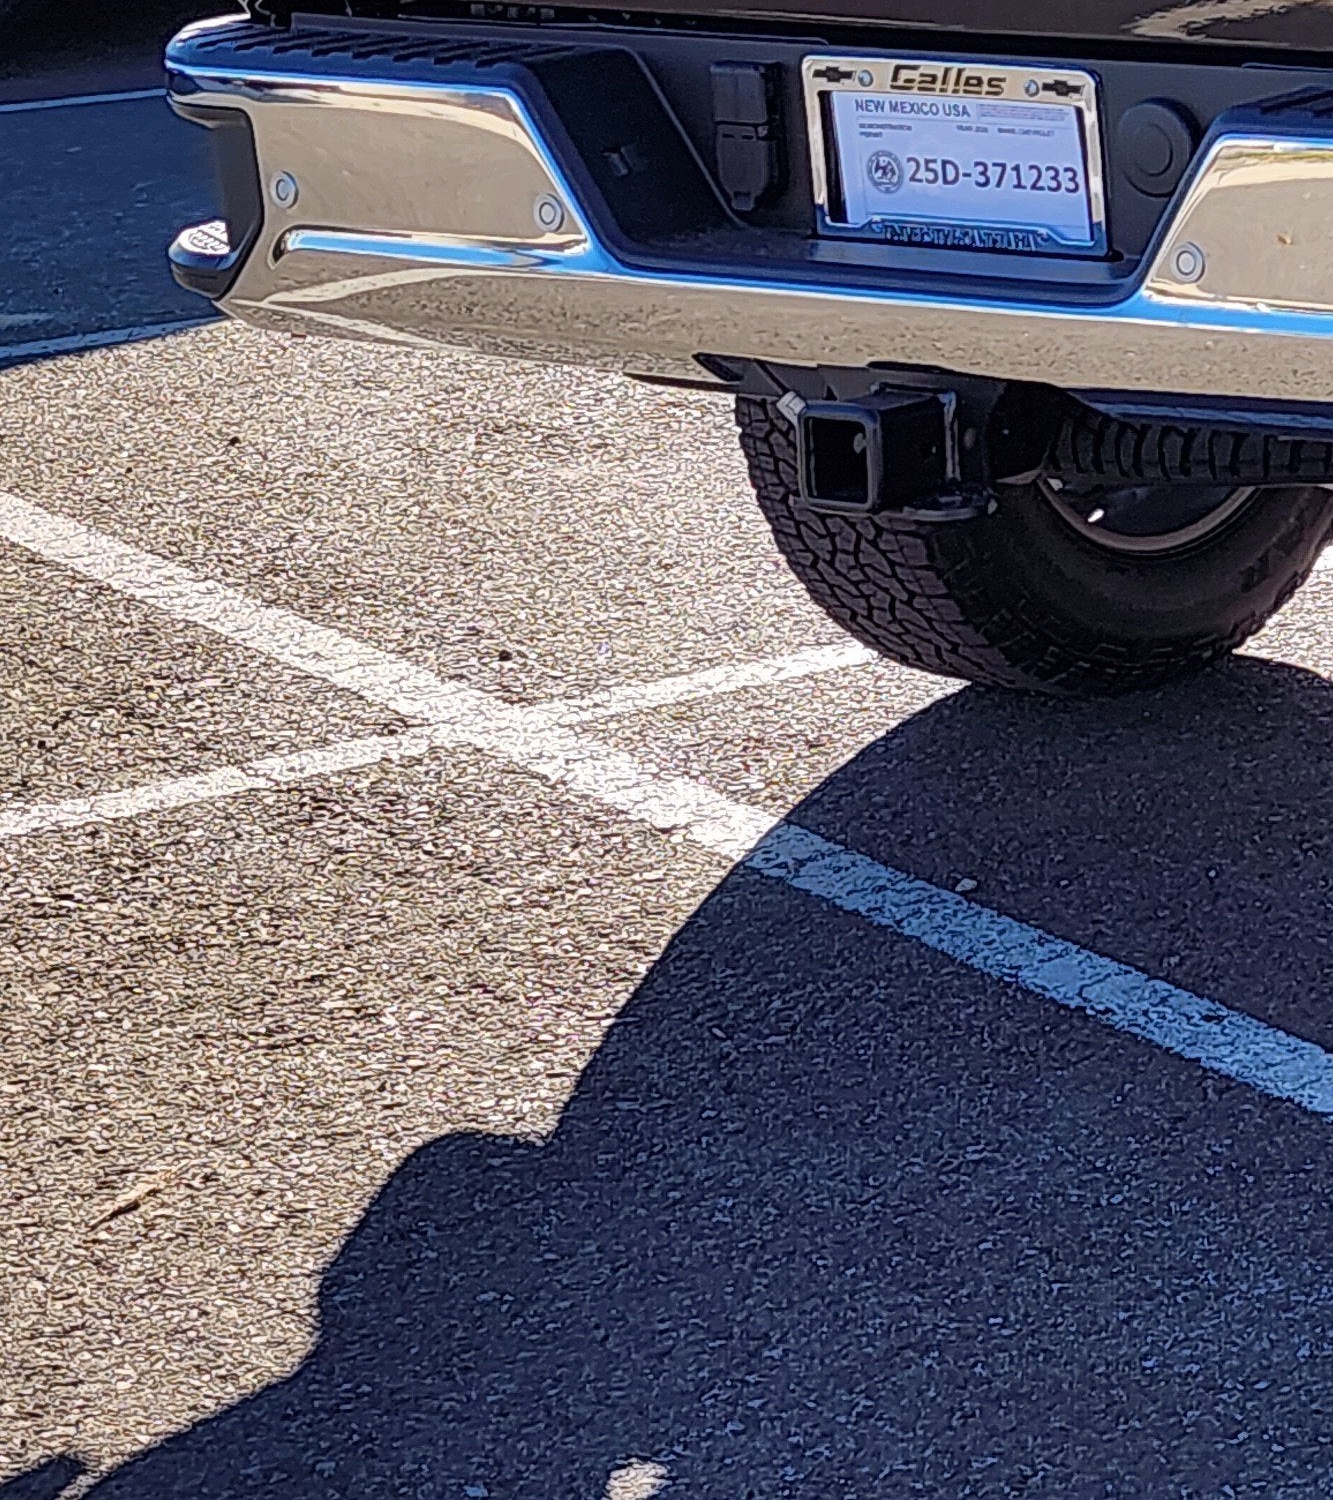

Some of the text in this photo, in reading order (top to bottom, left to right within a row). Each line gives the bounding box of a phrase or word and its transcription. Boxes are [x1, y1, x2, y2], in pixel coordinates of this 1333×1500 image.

[889, 64, 1007, 97] Galles
[854, 99, 886, 113] NEW
[889, 100, 940, 116] MEXICO
[942, 103, 971, 118] USA
[906, 156, 1080, 194] 25D-371233
